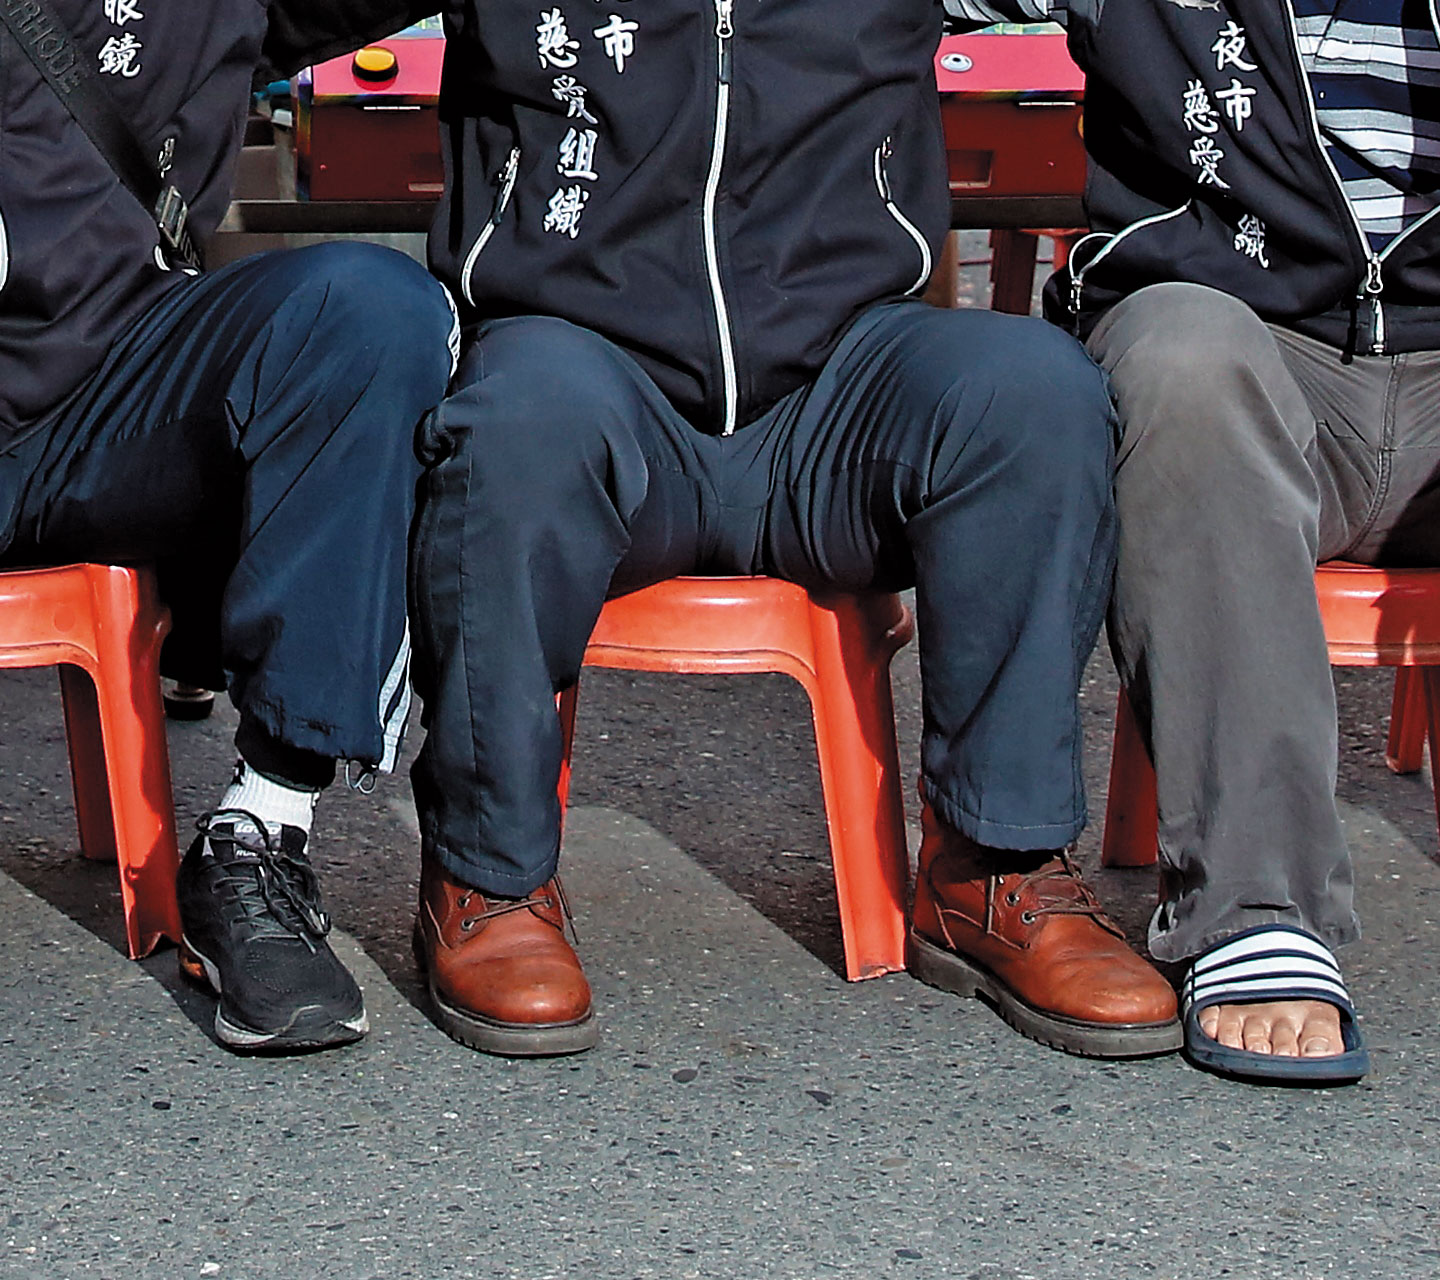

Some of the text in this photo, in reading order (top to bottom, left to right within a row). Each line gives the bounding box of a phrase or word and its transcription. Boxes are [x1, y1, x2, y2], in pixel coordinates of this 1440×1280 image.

[536, 8, 599, 239] 慈愛組織
[1211, 21, 1258, 132] 夜市
